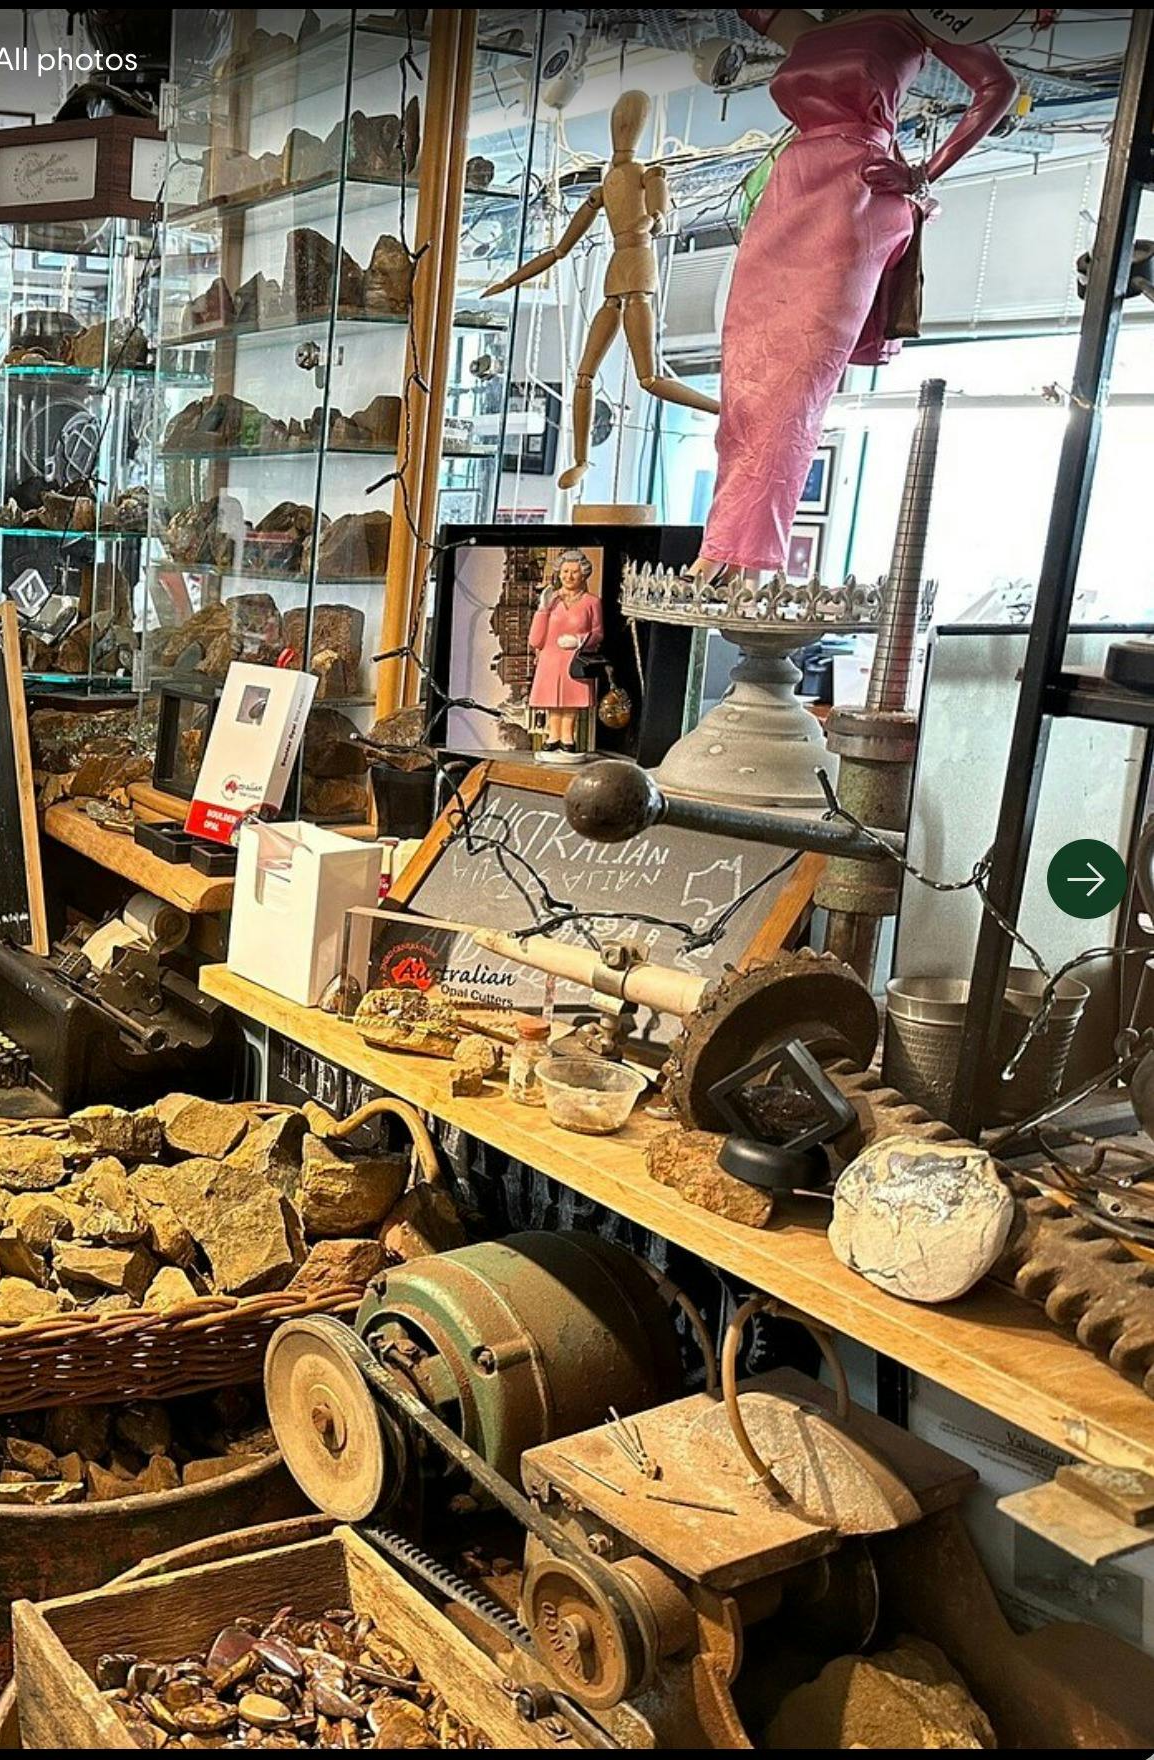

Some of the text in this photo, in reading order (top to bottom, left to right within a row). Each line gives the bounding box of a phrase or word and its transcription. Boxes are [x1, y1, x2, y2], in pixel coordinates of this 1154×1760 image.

[928, 9, 974, 35] end
[440, 983, 469, 998] Opal
[470, 990, 514, 1008] Cutters
